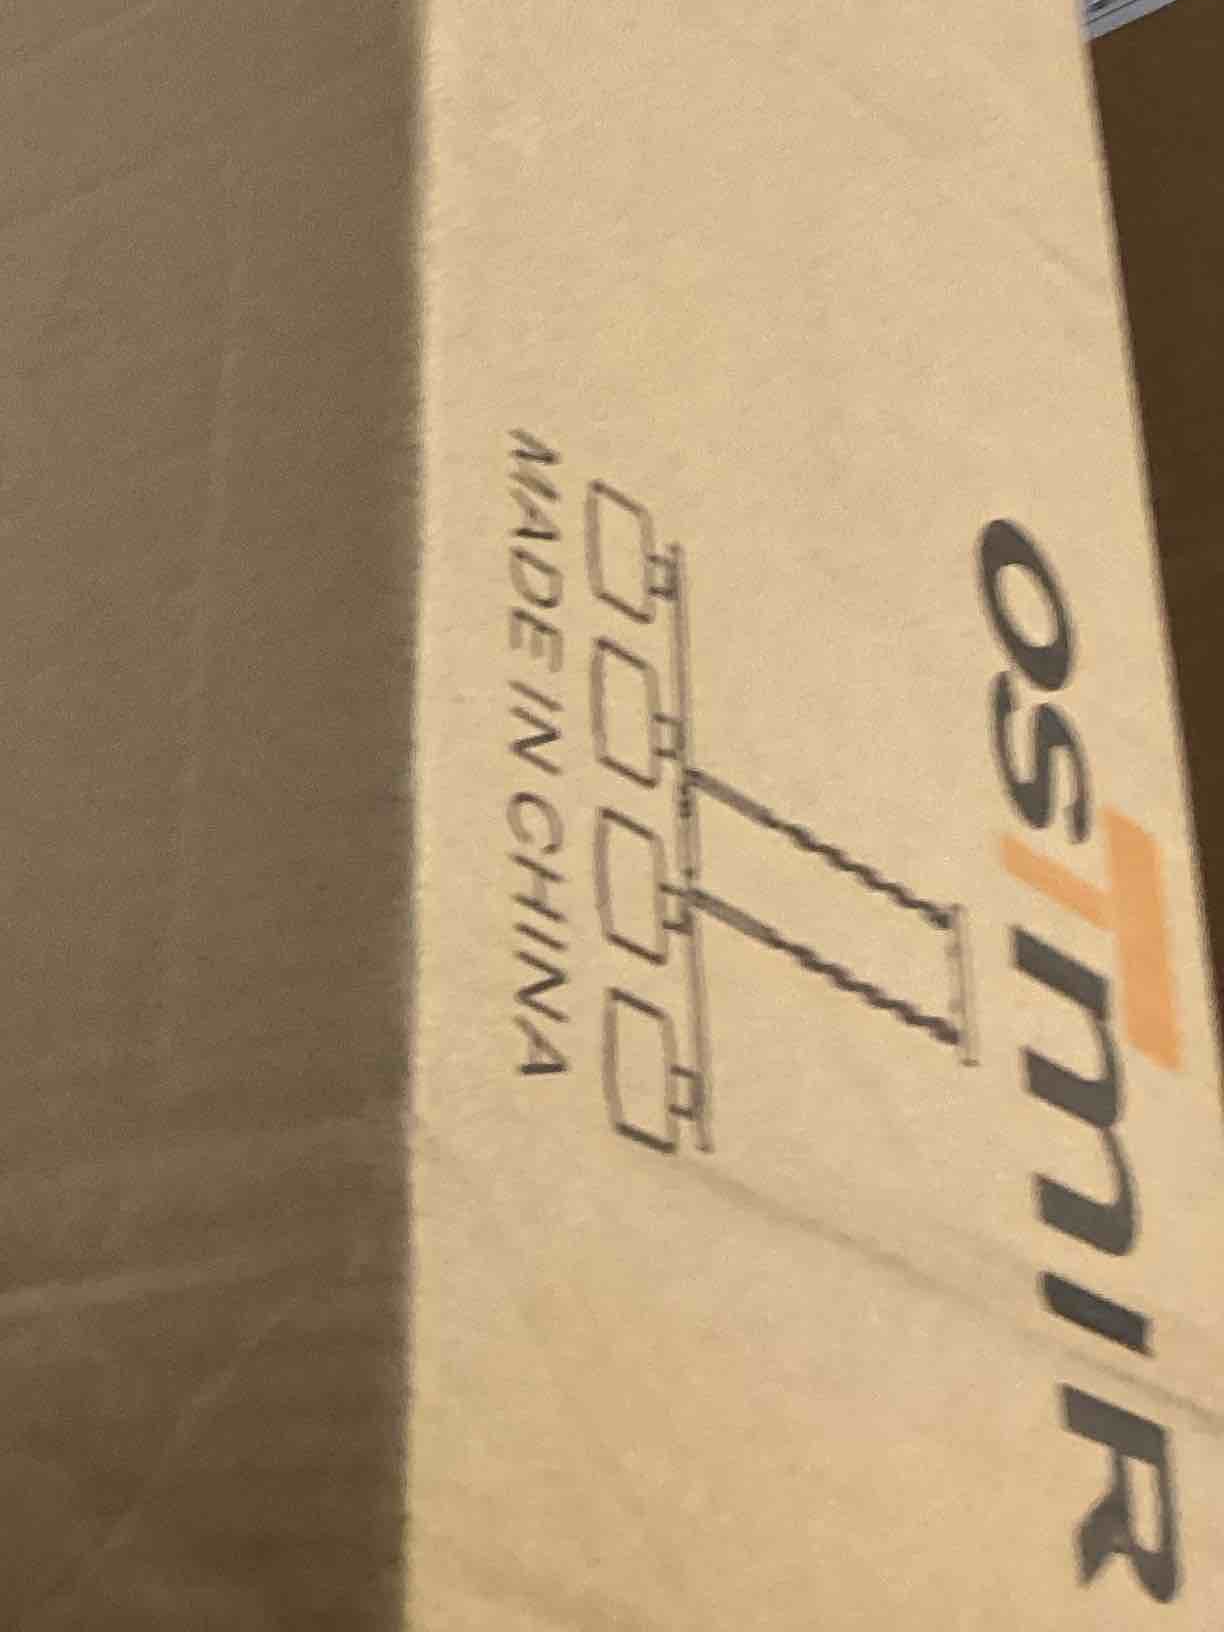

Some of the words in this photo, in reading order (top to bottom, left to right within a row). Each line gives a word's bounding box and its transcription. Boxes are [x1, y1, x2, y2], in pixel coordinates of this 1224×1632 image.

[509, 428, 564, 672] MADE
[509, 680, 563, 776] IN
[506, 793, 569, 1075] CHINA
